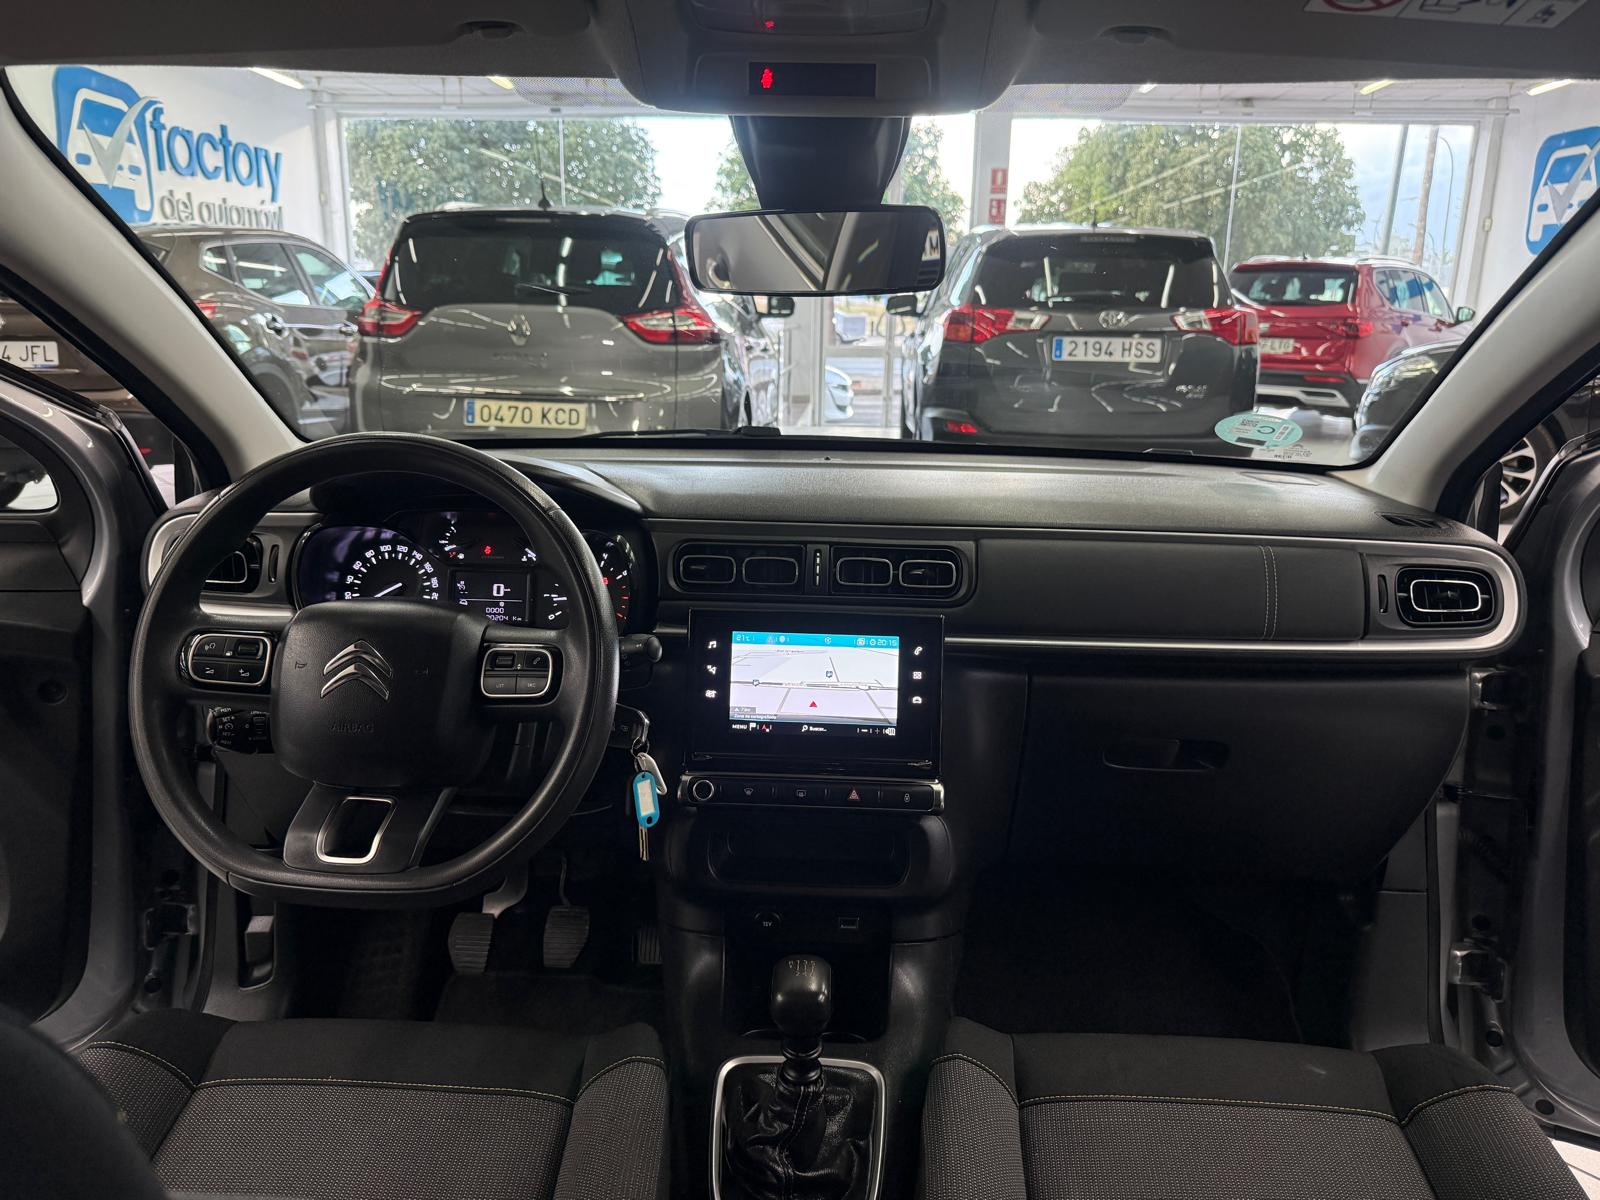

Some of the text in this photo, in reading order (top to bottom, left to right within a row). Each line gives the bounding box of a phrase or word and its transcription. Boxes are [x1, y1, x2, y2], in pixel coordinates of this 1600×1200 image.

[149, 106, 282, 203] factory
[160, 189, 195, 222] del
[1068, 340, 1156, 359] 2194 HSS
[480, 404, 580, 426] 0470 KCD
[364, 549, 375, 558] 80
[379, 544, 392, 552] 100
[396, 544, 409, 553] 120
[411, 550, 423, 561] 140
[352, 560, 363, 570] 60
[423, 561, 434, 573] 160
[345, 575, 354, 584] 40
[430, 577, 439, 588] 180
[492, 583, 505, 597] 0
